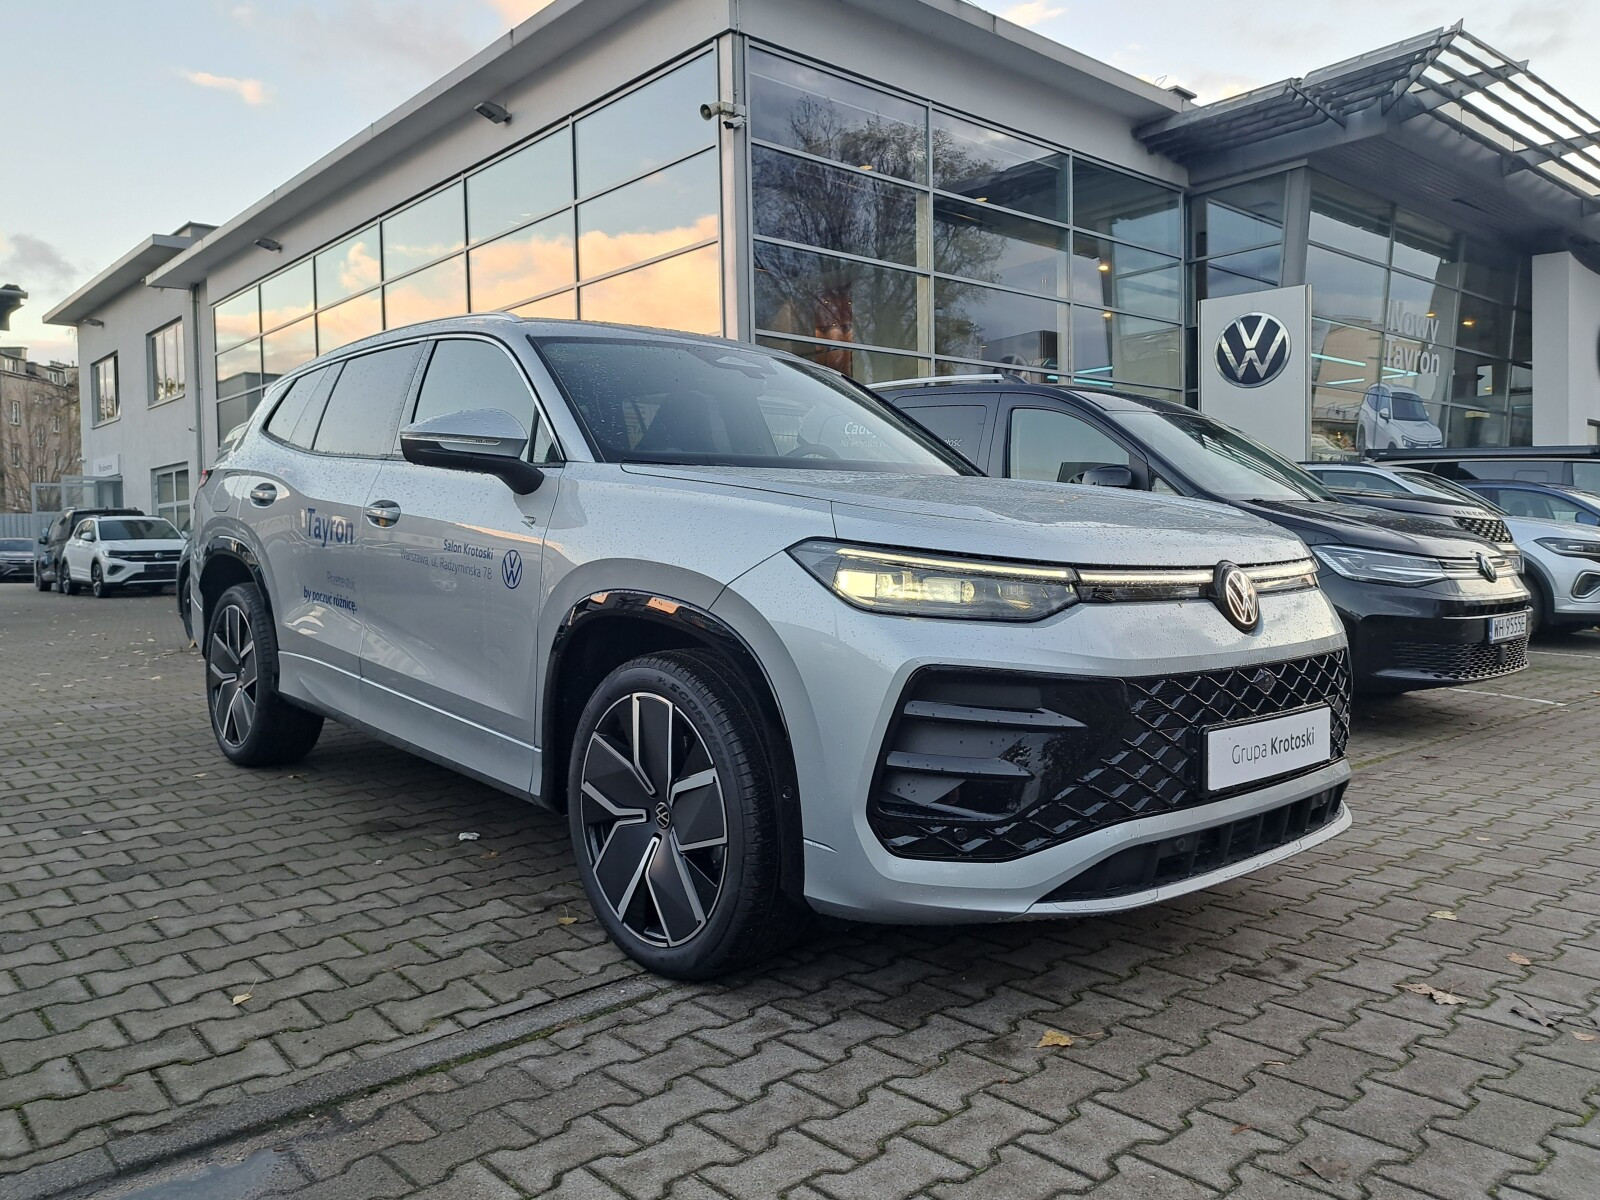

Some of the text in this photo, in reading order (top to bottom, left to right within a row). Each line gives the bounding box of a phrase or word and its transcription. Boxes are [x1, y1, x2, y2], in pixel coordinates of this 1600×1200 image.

[1386, 300, 1440, 350] Nowy
[307, 507, 354, 548] Tayron
[443, 539, 494, 561] Salon Krotoski
[483, 567, 493, 580] 78
[303, 585, 312, 602] by
[1494, 619, 1504, 638] WH
[1231, 726, 1315, 765] Grupa Krotoski
